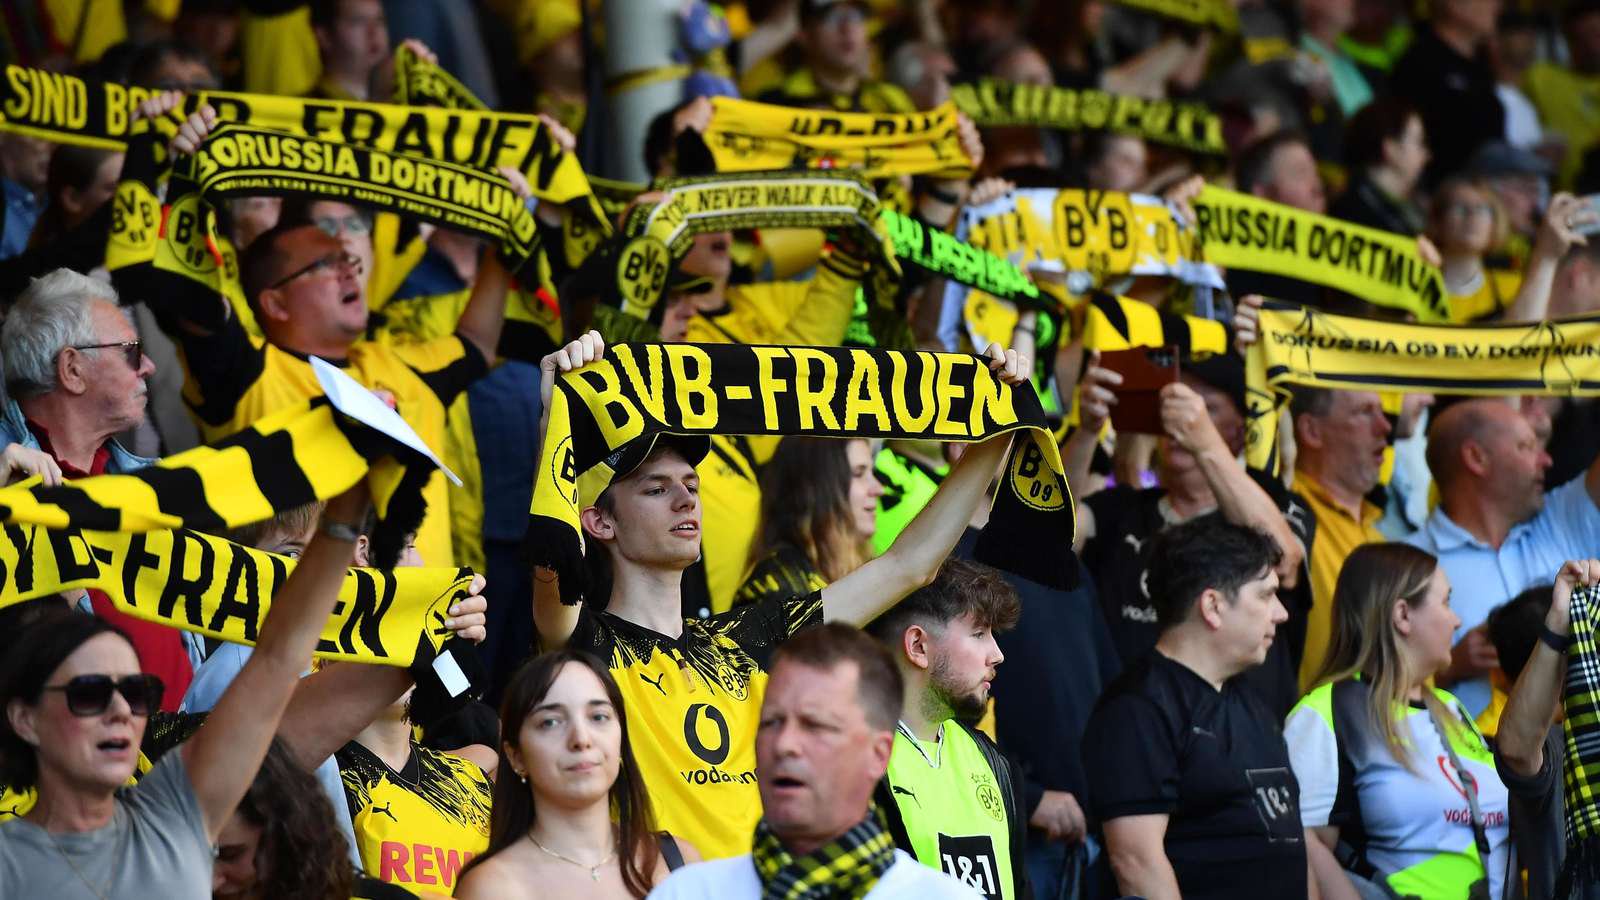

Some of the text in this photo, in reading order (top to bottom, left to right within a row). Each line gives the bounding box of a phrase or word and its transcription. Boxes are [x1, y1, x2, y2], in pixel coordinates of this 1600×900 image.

[5, 64, 88, 130] SIND
[370, 152, 537, 243] DORTMUND
[699, 186, 760, 211] NEVER
[766, 185, 813, 208] WALK
[1065, 189, 1129, 250] BVB
[1307, 223, 1446, 318] DORTMUN
[561, 343, 1019, 451] BVB-FRAUEN
[721, 667, 745, 692] BVB
[942, 853, 997, 895] 1&1
